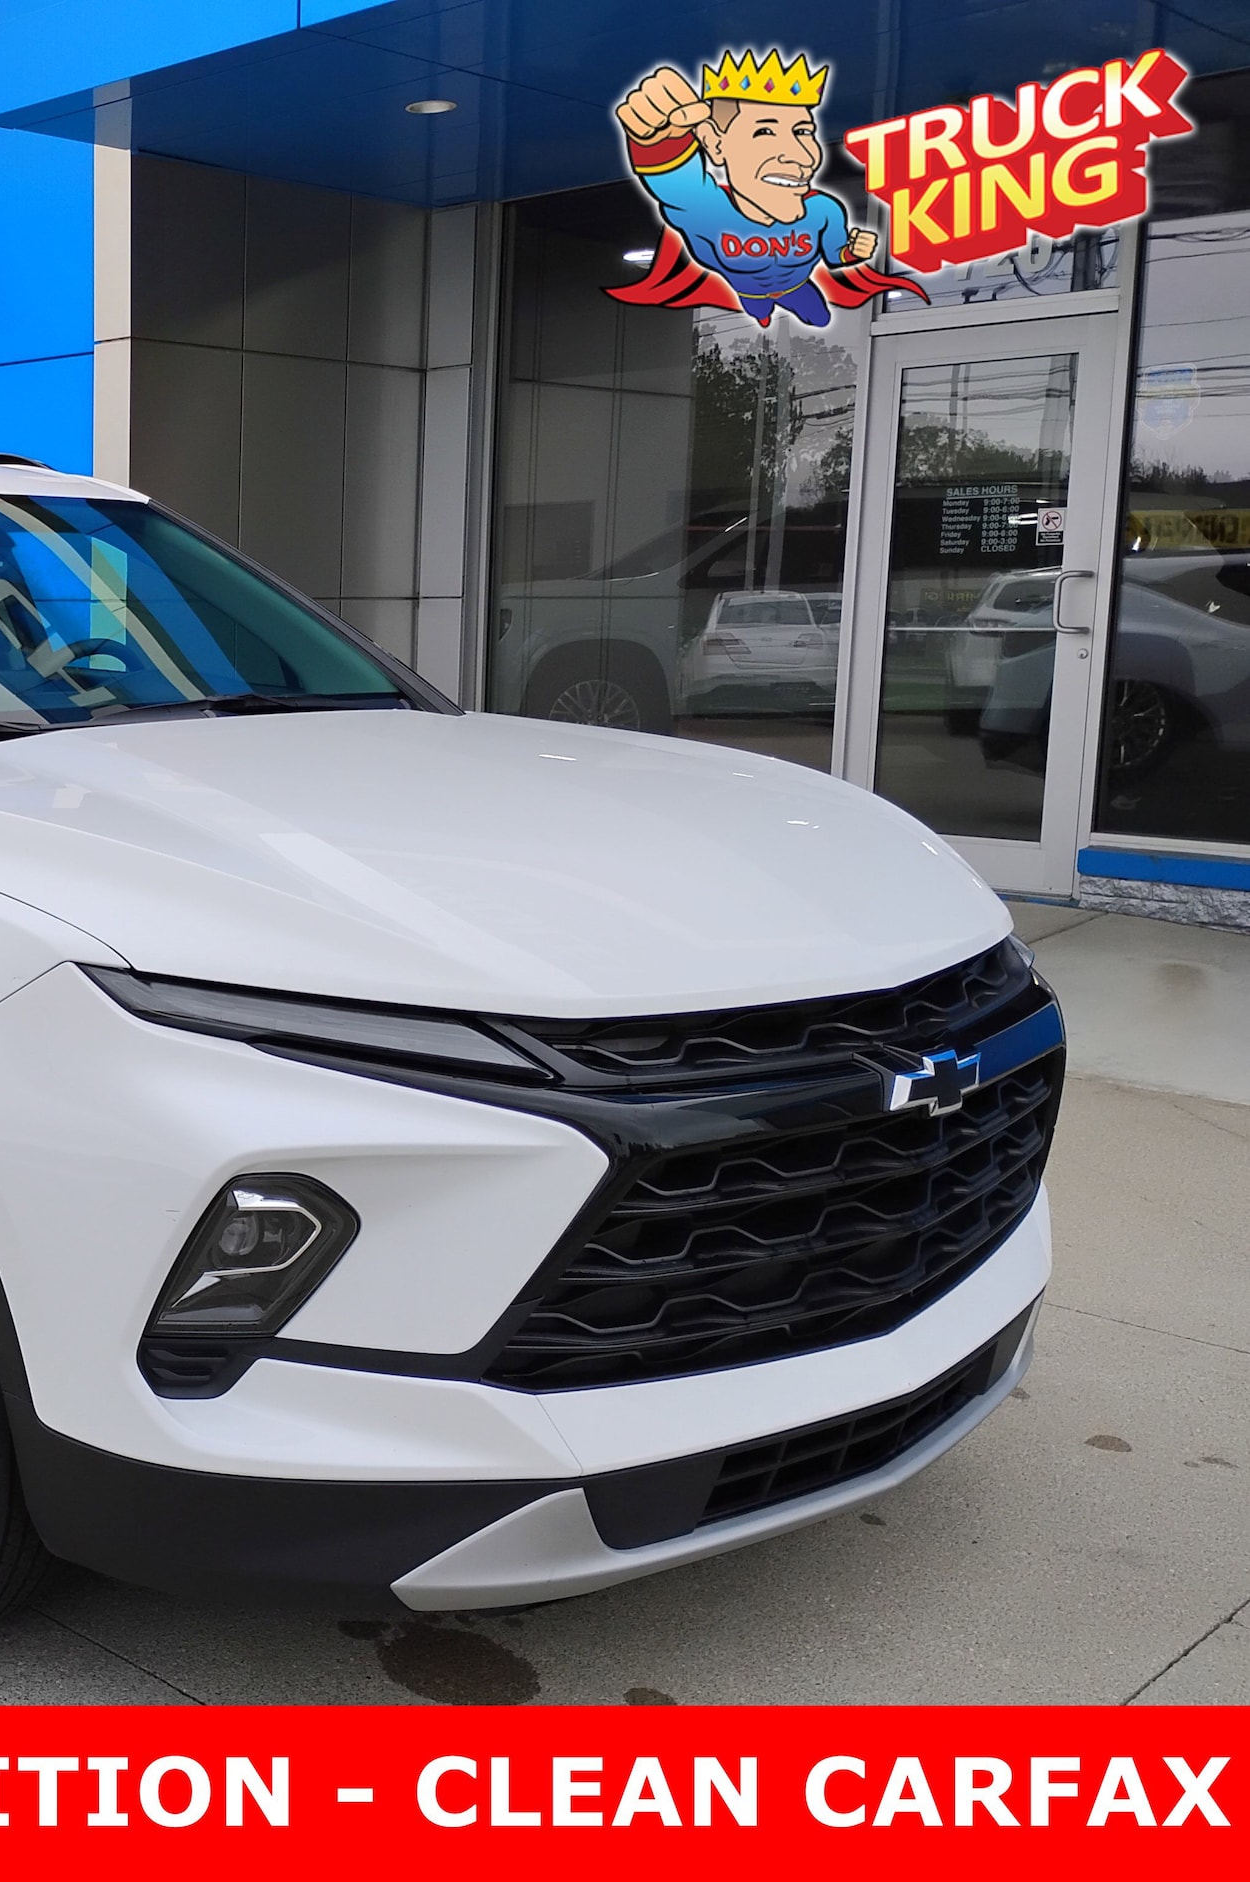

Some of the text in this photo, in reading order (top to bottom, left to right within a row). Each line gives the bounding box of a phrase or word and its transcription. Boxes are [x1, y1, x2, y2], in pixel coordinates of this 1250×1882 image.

[946, 485, 1018, 497] SALES HOURS
[942, 507, 969, 515] Tuesday
[940, 531, 962, 539] Friday
[940, 539, 969, 547] Saturday
[980, 544, 1016, 552] CLOSED
